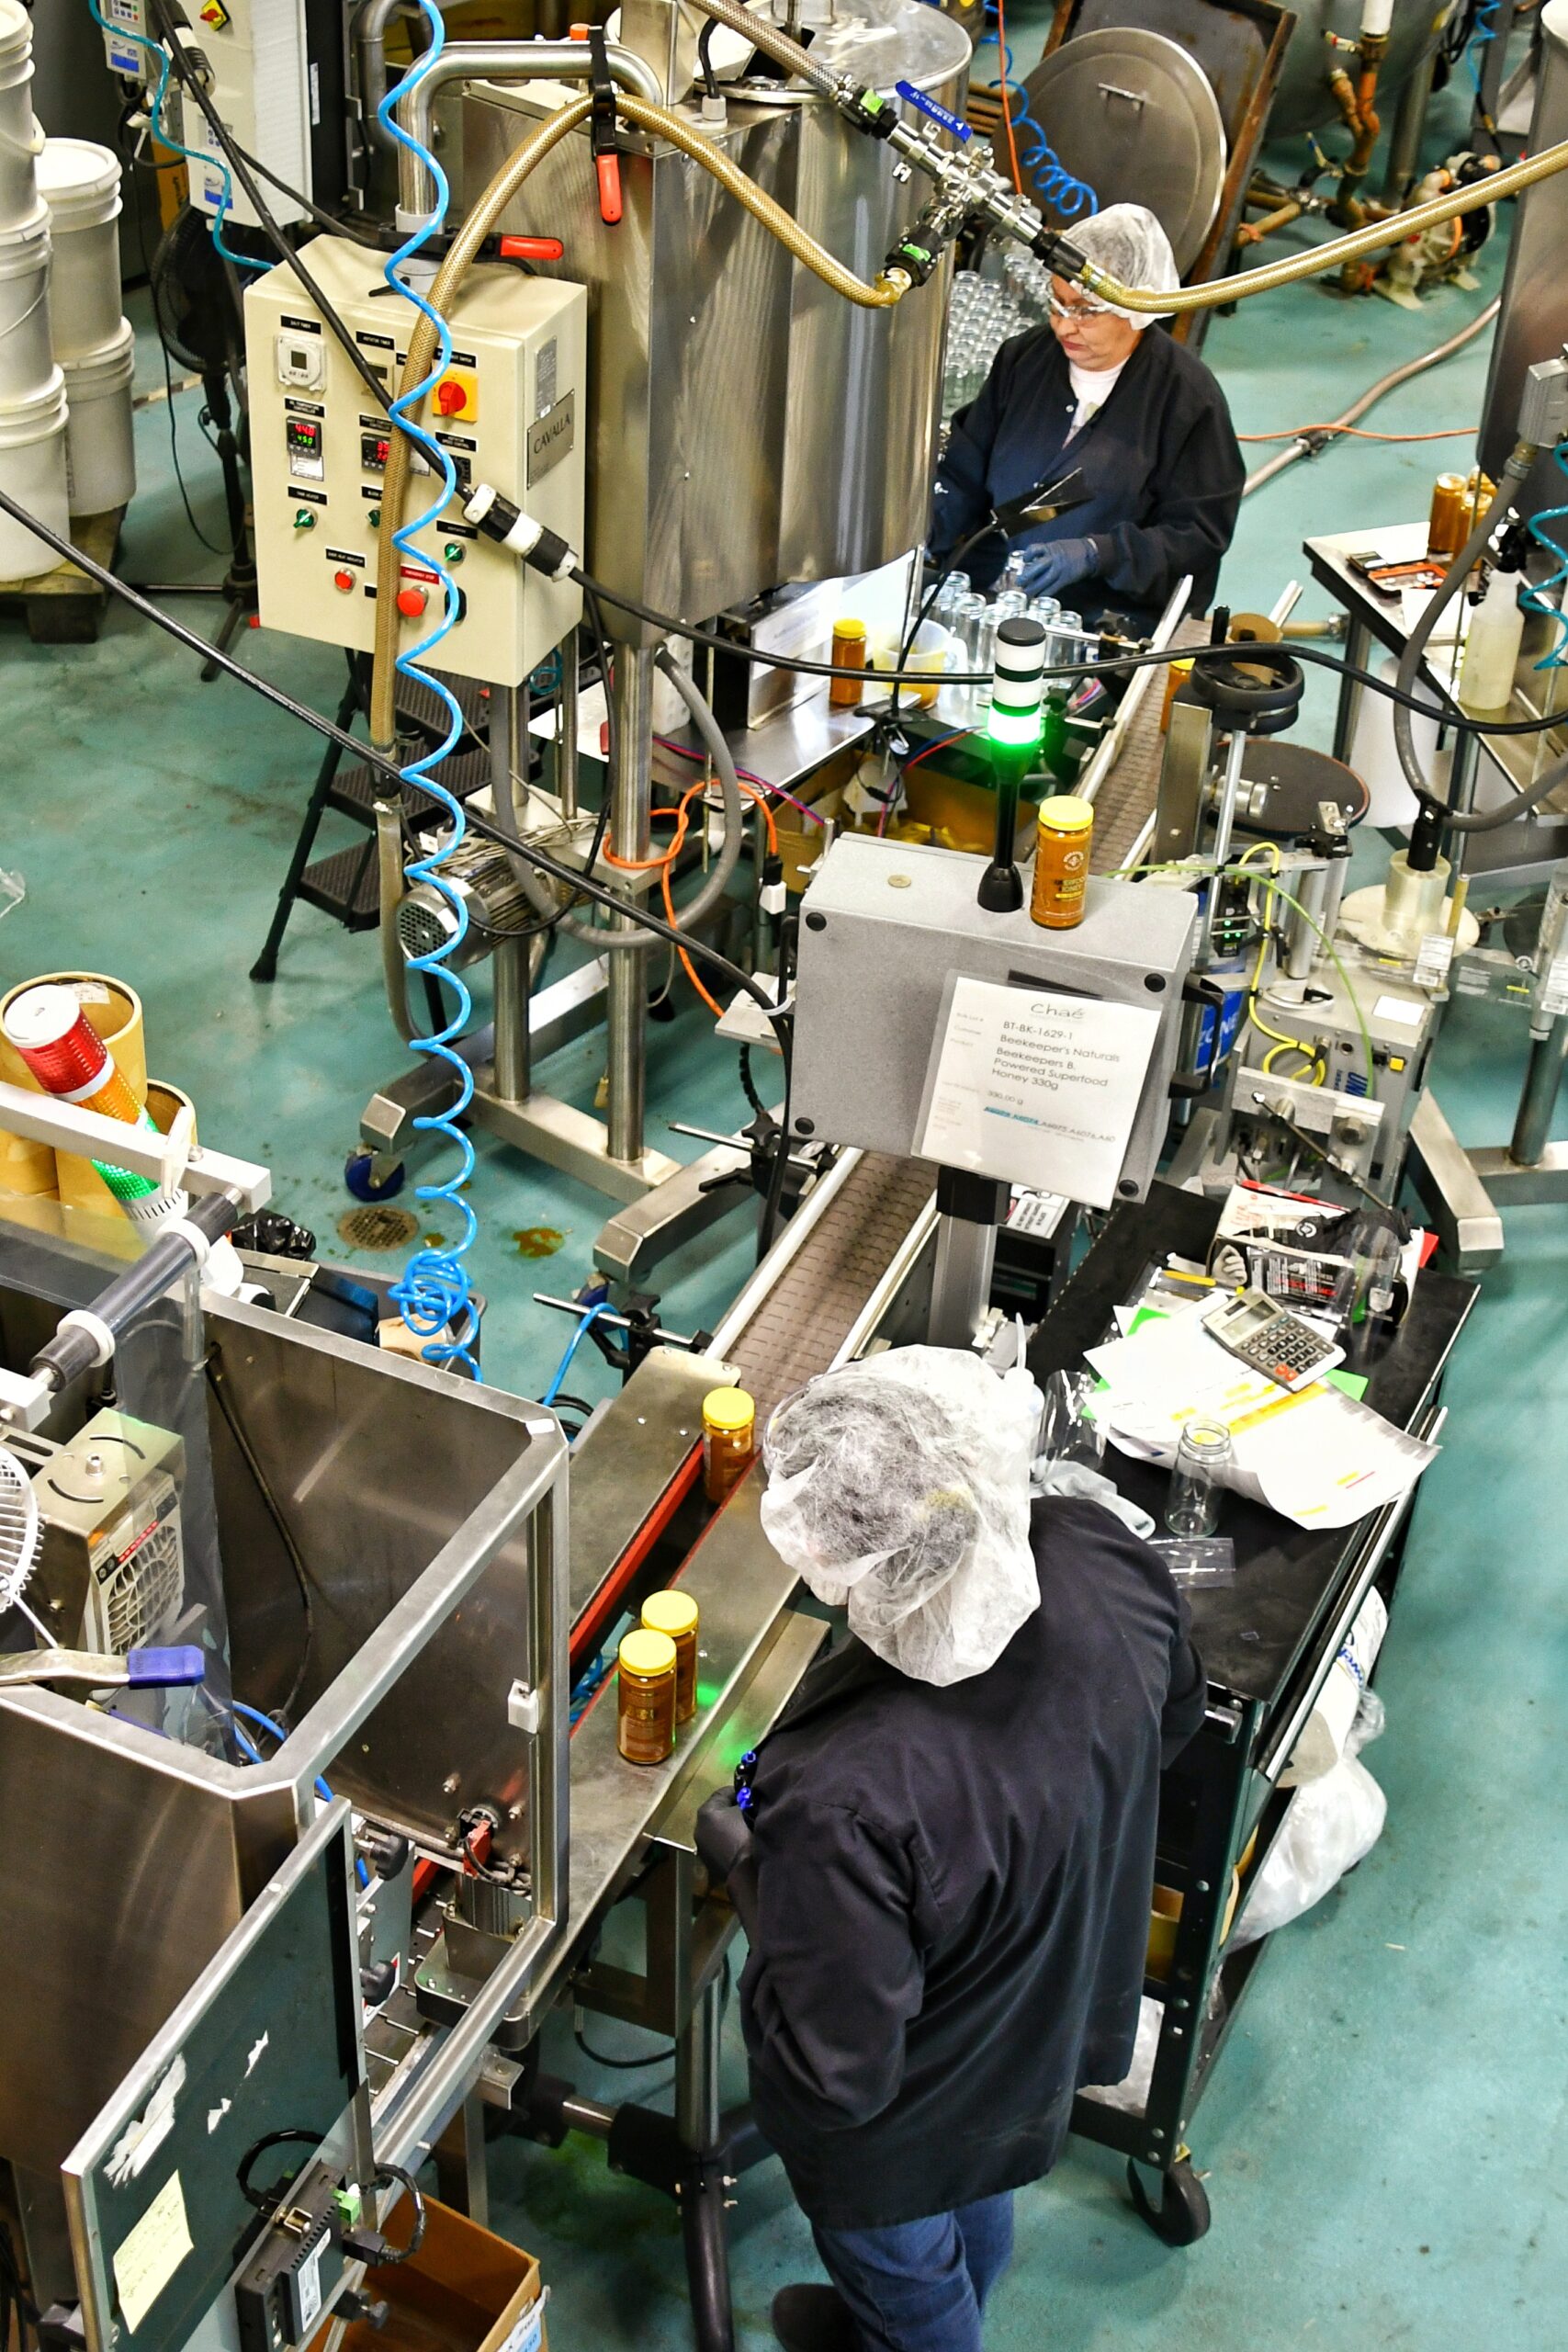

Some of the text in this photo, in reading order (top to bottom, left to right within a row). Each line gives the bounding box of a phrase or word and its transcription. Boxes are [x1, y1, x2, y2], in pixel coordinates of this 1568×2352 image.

[534, 413, 571, 454] CAVALLA
[1031, 1002, 1085, 1020] Chaé
[1003, 1021, 1073, 1040] BT-BK-1629-1
[997, 1046, 1076, 1069] Beekeepers B.
[1000, 1035, 1121, 1063] Beekeeper's Naturals
[992, 1068, 1059, 1091] Honey 330g
[994, 1058, 1108, 1087] Powered Superfood
[987, 1090, 1015, 1102] 330.00
